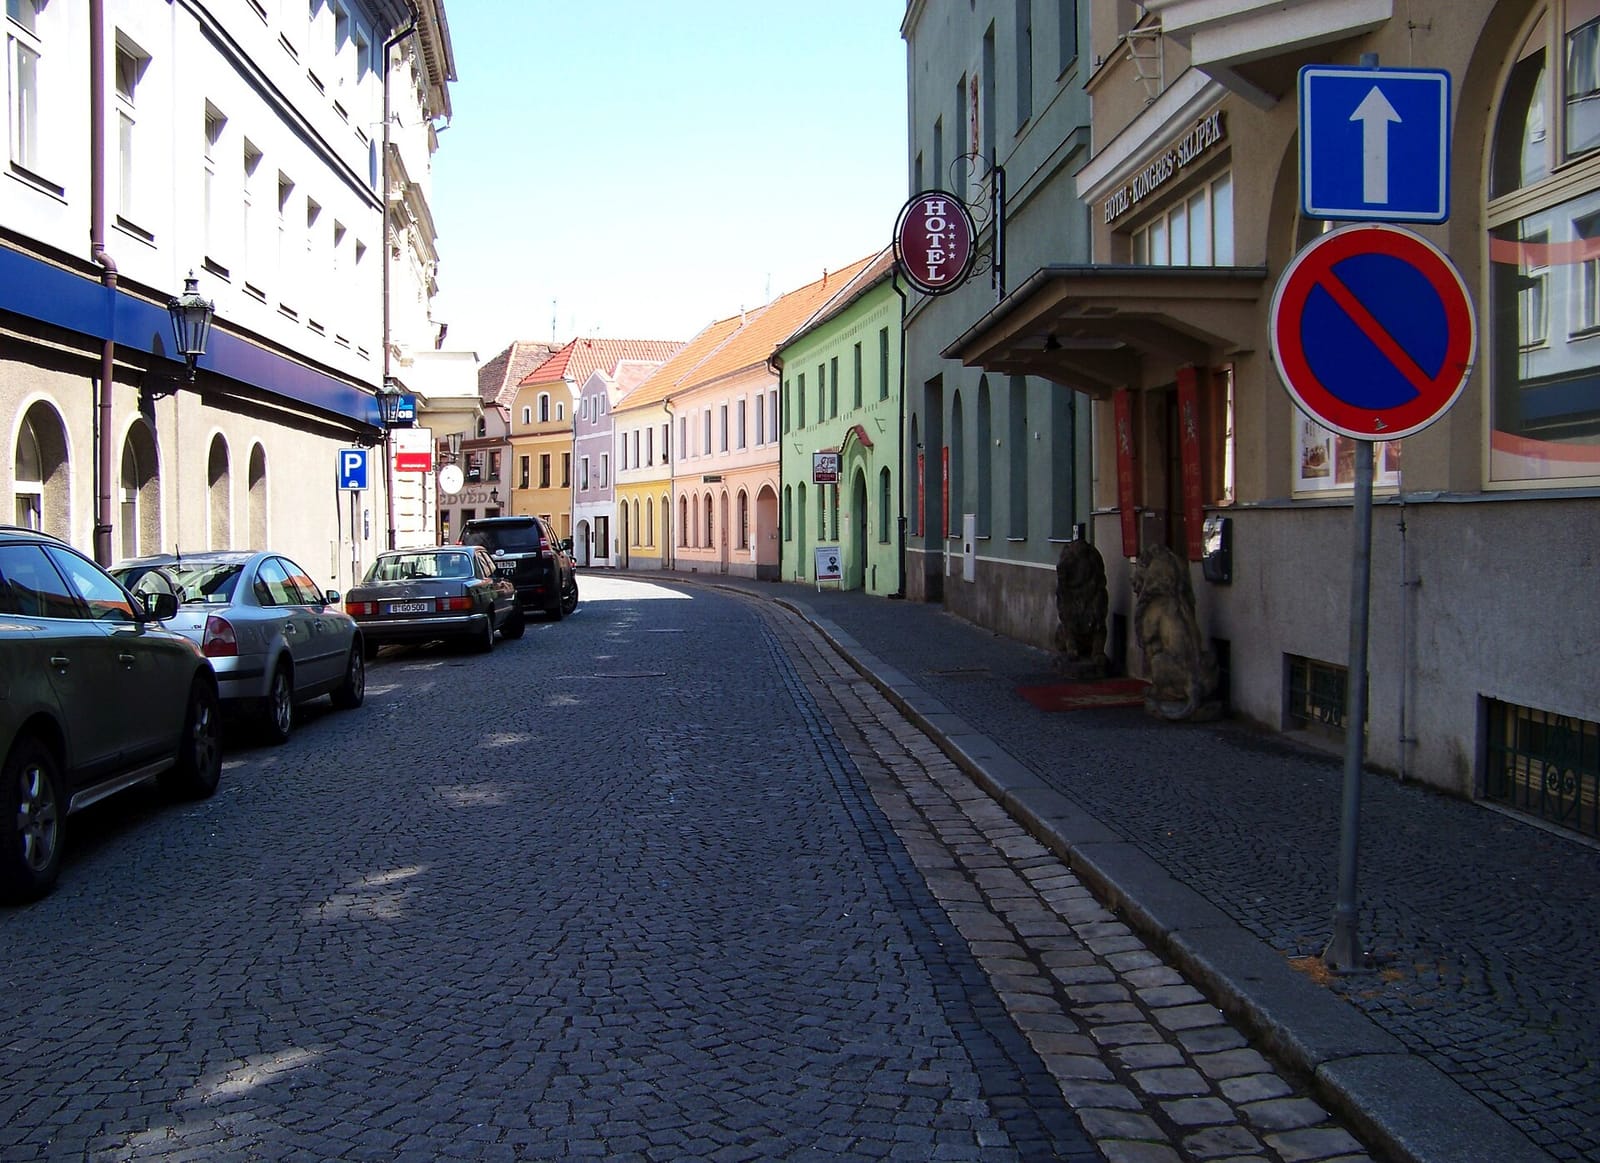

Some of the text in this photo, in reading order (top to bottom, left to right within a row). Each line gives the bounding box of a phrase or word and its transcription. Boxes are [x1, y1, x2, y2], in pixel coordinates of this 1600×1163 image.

[1104, 186, 1130, 224] HOTEL
[1132, 151, 1173, 204] KONGRES
[924, 201, 946, 280] HOTEL
[345, 453, 362, 478] P
